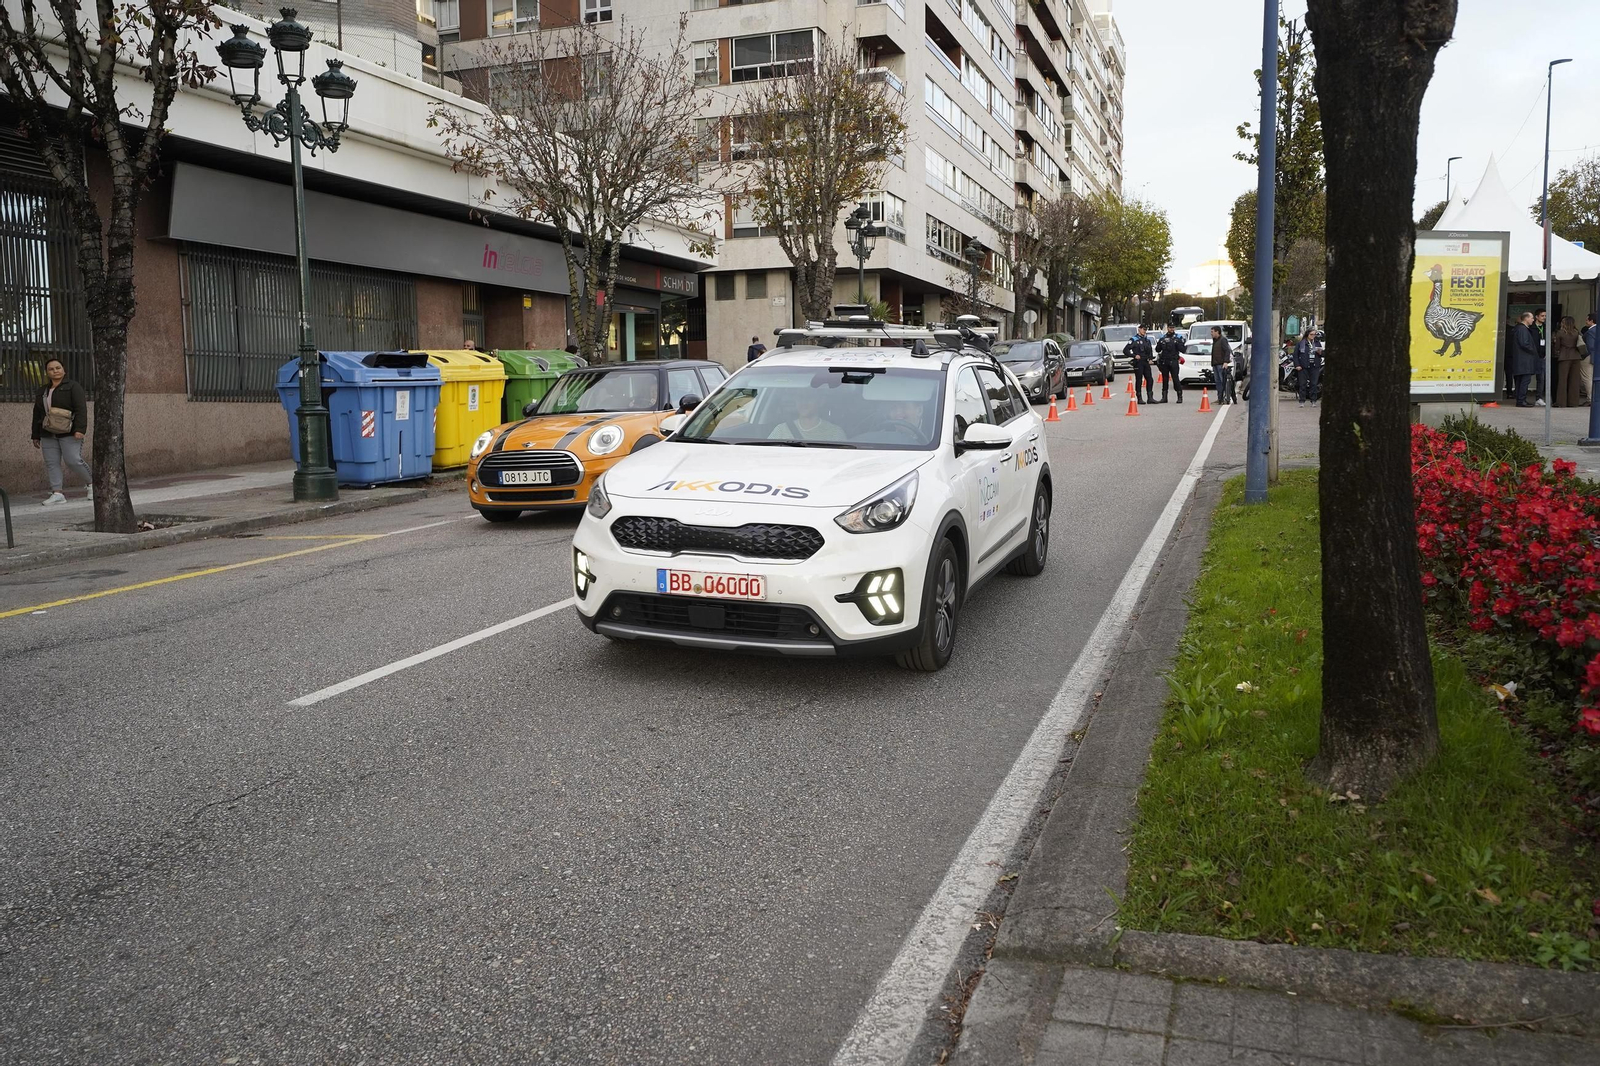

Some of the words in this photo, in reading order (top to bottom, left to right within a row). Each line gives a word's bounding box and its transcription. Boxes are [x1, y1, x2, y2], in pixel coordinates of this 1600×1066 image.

[1451, 267, 1485, 275] HEMATO
[1450, 276, 1485, 288] FESTI
[504, 472, 528, 482] 0813
[531, 471, 549, 482] JTC
[670, 573, 692, 592] BB
[704, 575, 760, 596] 06000
